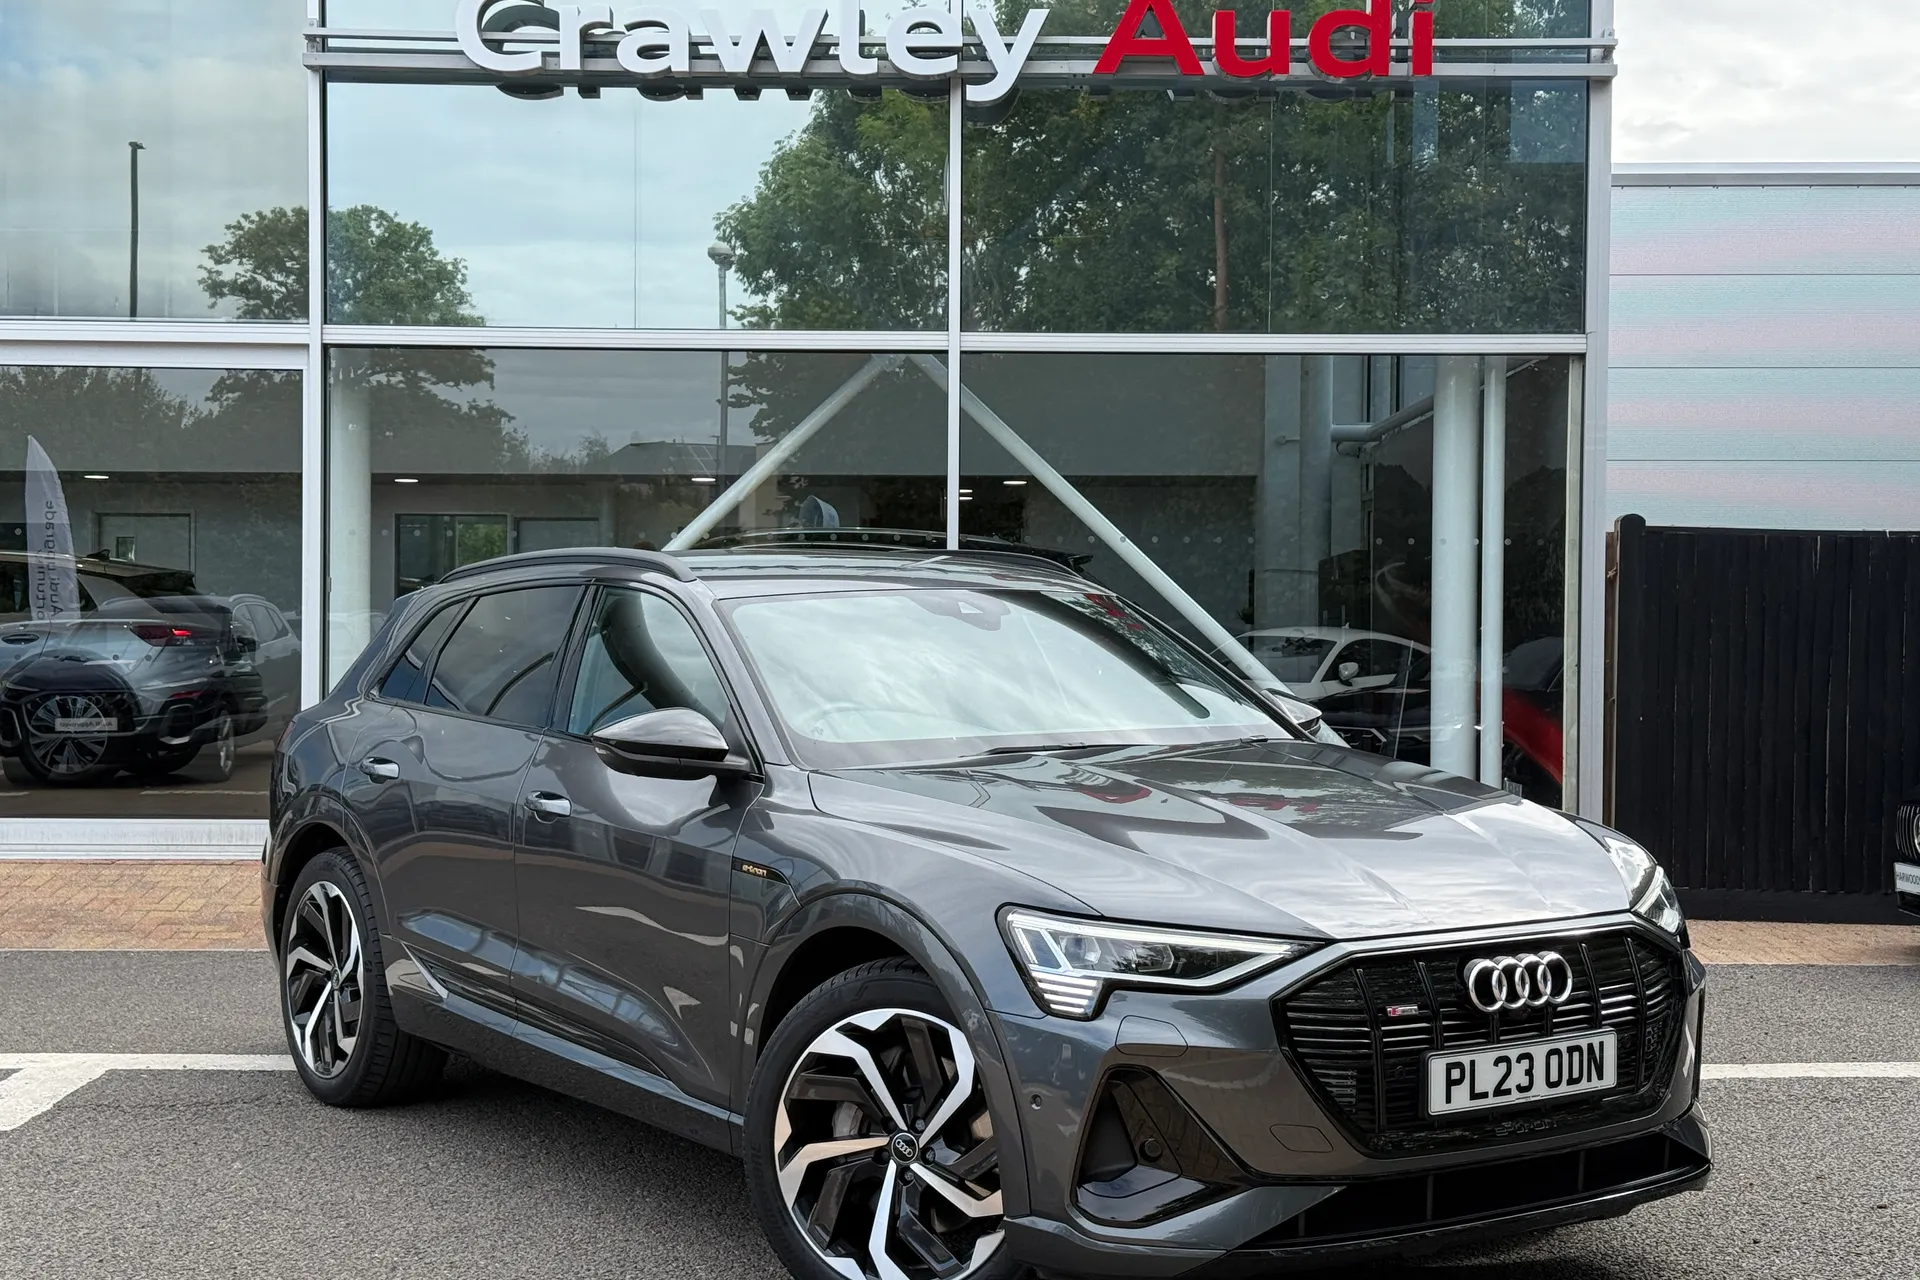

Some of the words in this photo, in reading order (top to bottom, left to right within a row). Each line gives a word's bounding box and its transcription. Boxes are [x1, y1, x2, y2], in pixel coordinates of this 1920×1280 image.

[455, 0, 1050, 102] Crawley
[1093, 0, 1433, 78] Audi
[1445, 1051, 1535, 1104] PL23
[1544, 1040, 1605, 1089] ODN
